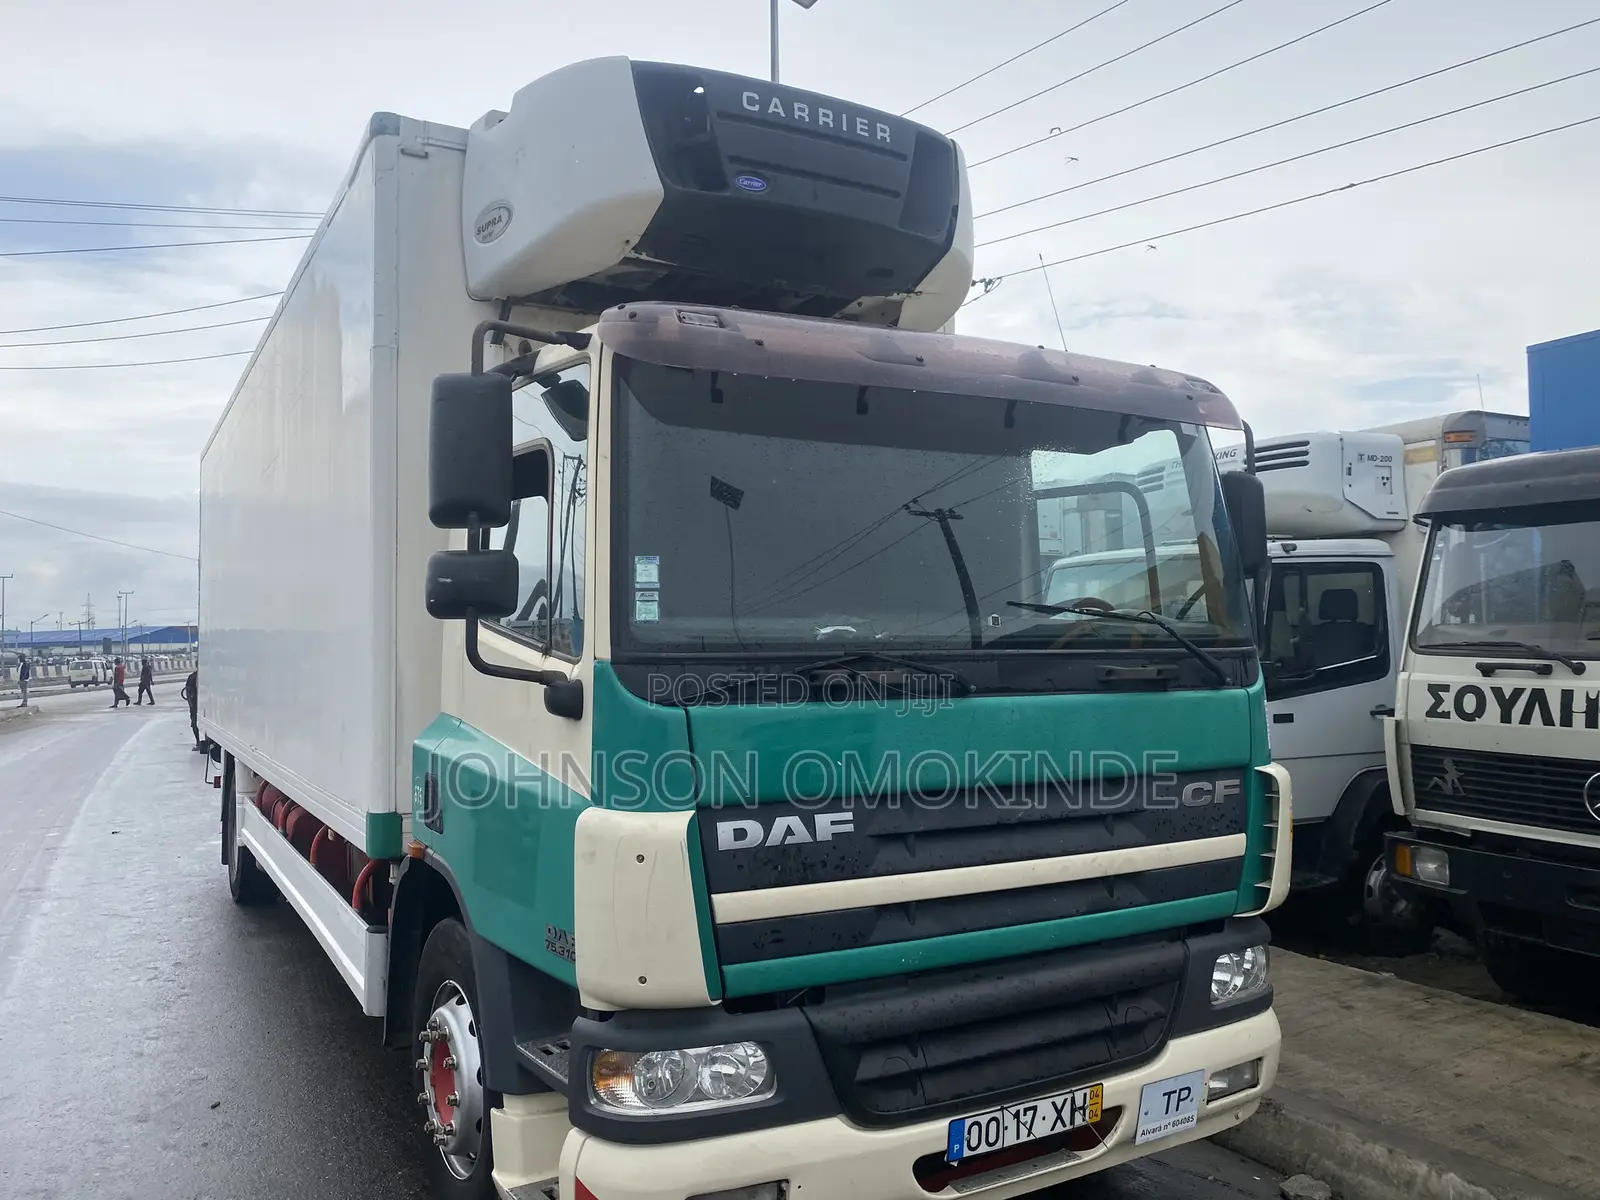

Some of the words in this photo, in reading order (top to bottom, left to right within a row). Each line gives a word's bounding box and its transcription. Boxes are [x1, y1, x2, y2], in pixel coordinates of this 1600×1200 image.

[742, 91, 891, 143] CARRIER
[739, 178, 763, 188] Carrier
[476, 214, 503, 236] SUPRA
[1367, 454, 1393, 463] MD-200
[1181, 778, 1241, 808] CF
[716, 811, 854, 851] DAF
[1089, 1088, 1100, 1100] 04
[1162, 1086, 1192, 1115] TP
[1088, 1109, 1099, 1120] 04
[1140, 1125, 1162, 1138] Alvará
[953, 1144, 960, 1153] P
